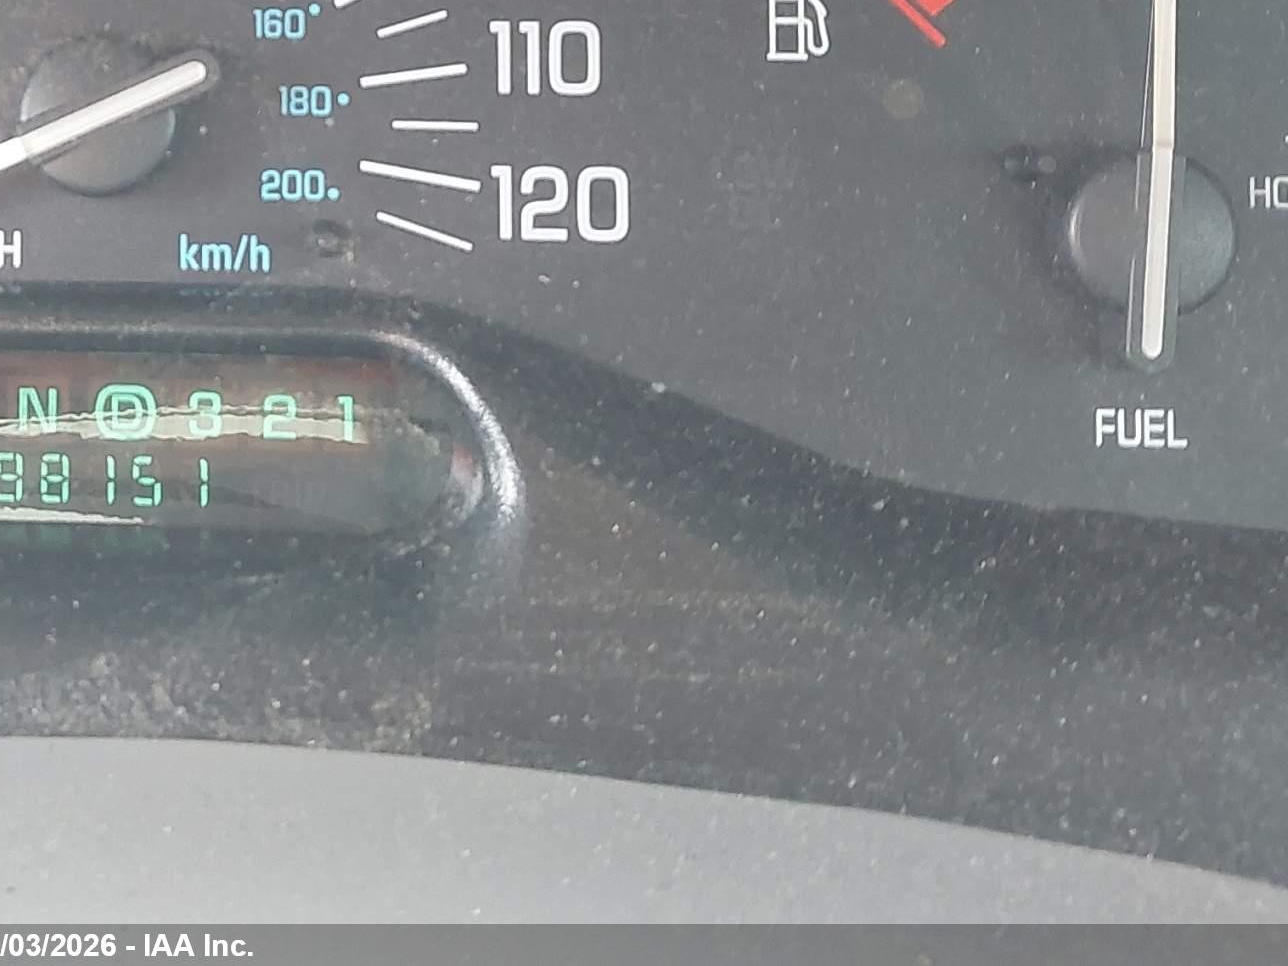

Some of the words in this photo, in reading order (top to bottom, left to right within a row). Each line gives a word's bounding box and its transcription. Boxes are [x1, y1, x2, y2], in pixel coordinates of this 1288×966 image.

[253, 9, 304, 38] 160
[490, 21, 600, 95] 110
[280, 86, 331, 116] 180
[262, 170, 324, 201] 200
[491, 166, 628, 242] 120
[180, 234, 269, 272] km/h
[16, 386, 59, 434] N
[188, 392, 221, 437] 3
[262, 395, 297, 440] 2
[334, 395, 356, 439] 1
[1096, 409, 1187, 448] FUEL
